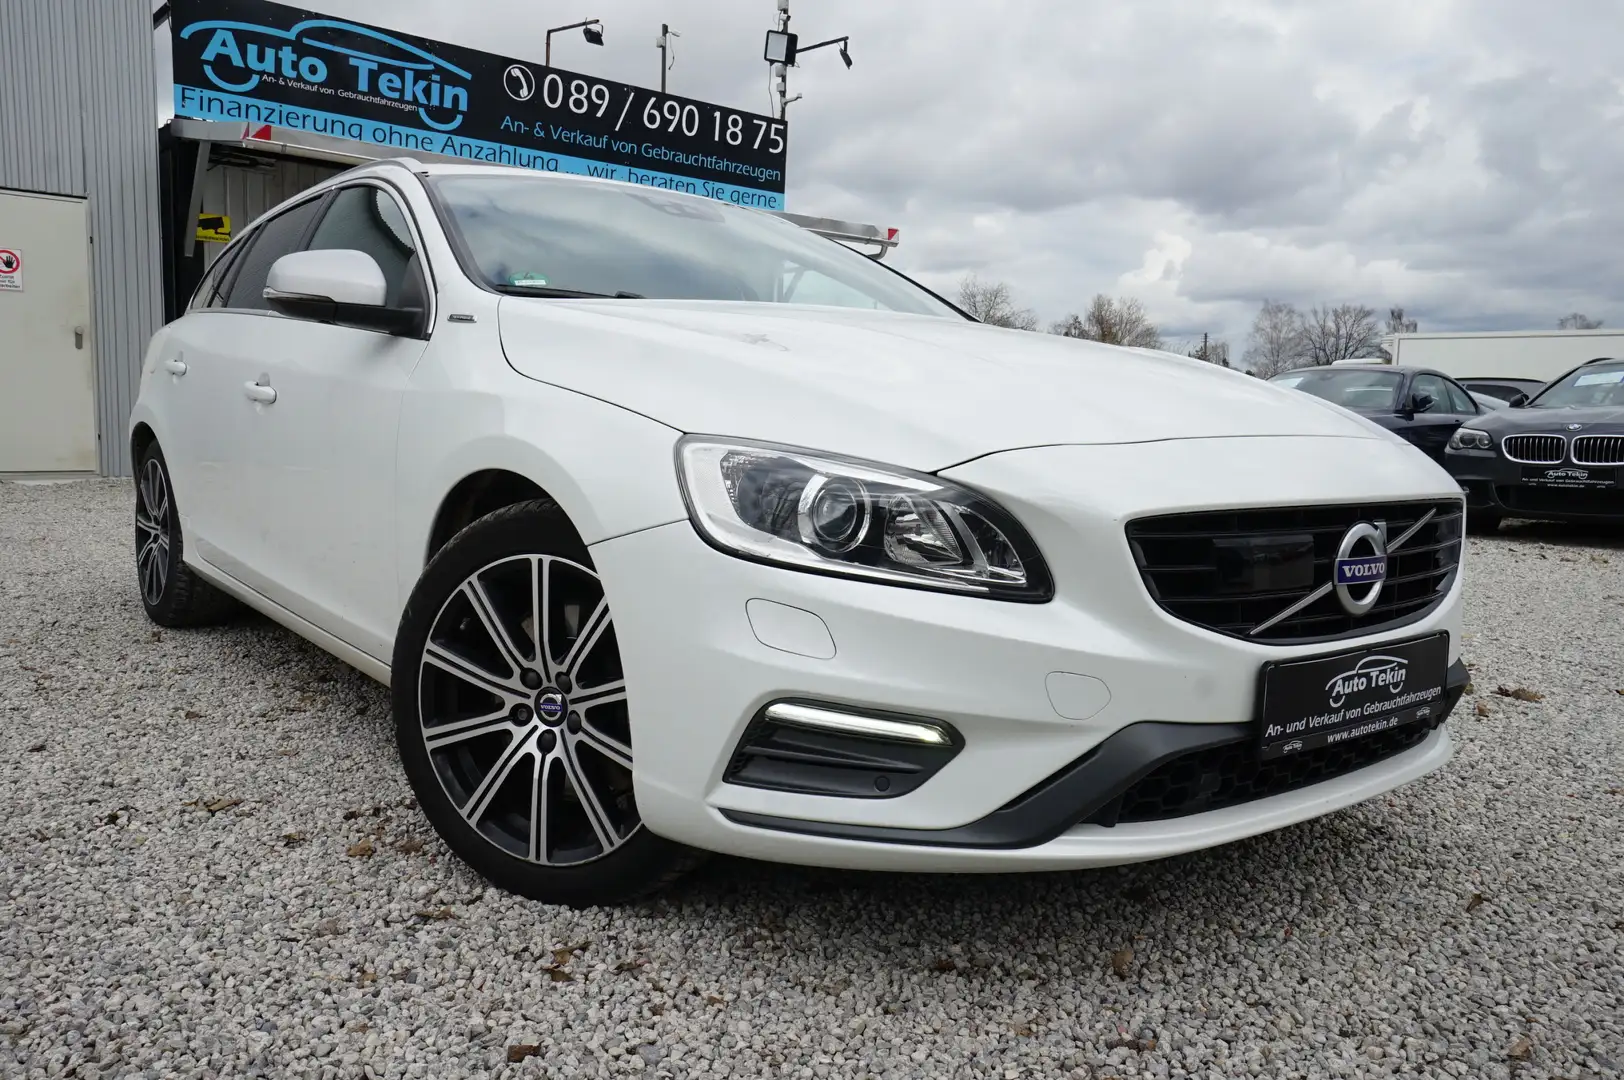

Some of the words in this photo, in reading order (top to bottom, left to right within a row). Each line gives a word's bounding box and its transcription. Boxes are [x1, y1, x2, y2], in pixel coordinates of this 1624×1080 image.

[200, 29, 328, 83] Auto
[349, 57, 468, 112] Tekin
[262, 74, 277, 84] An-
[278, 77, 285, 86] &
[286, 79, 318, 93] Verkauf
[319, 86, 335, 96] von
[338, 89, 418, 112] Gebrauchtfahrzeugen
[543, 74, 610, 118] 089
[615, 92, 635, 132] /
[643, 97, 699, 137] 690
[713, 111, 743, 146] 18
[752, 119, 785, 154] 75
[181, 86, 362, 142] Finanzierung
[372, 125, 434, 153] ohne
[440, 136, 559, 173] Anzahlung
[587, 163, 617, 180] wir
[628, 168, 696, 195] beraten
[702, 181, 724, 200] Sie
[500, 115, 529, 134] An-
[533, 121, 546, 138] &
[550, 124, 609, 149] Verkauf
[611, 139, 638, 155] von
[641, 143, 781, 182] Gebrauchtfahrzeugen
[1341, 562, 1385, 578] VOLVO
[1332, 674, 1367, 697] Auto
[1370, 666, 1406, 688] Tekin
[1265, 723, 1284, 738] An-
[1286, 716, 1306, 734] und
[1308, 709, 1344, 730] Verkauf
[1345, 705, 1361, 720] von
[1363, 685, 1442, 716] Gebrauchtfahrzeugen
[1327, 716, 1399, 744] www.autotekin.de
